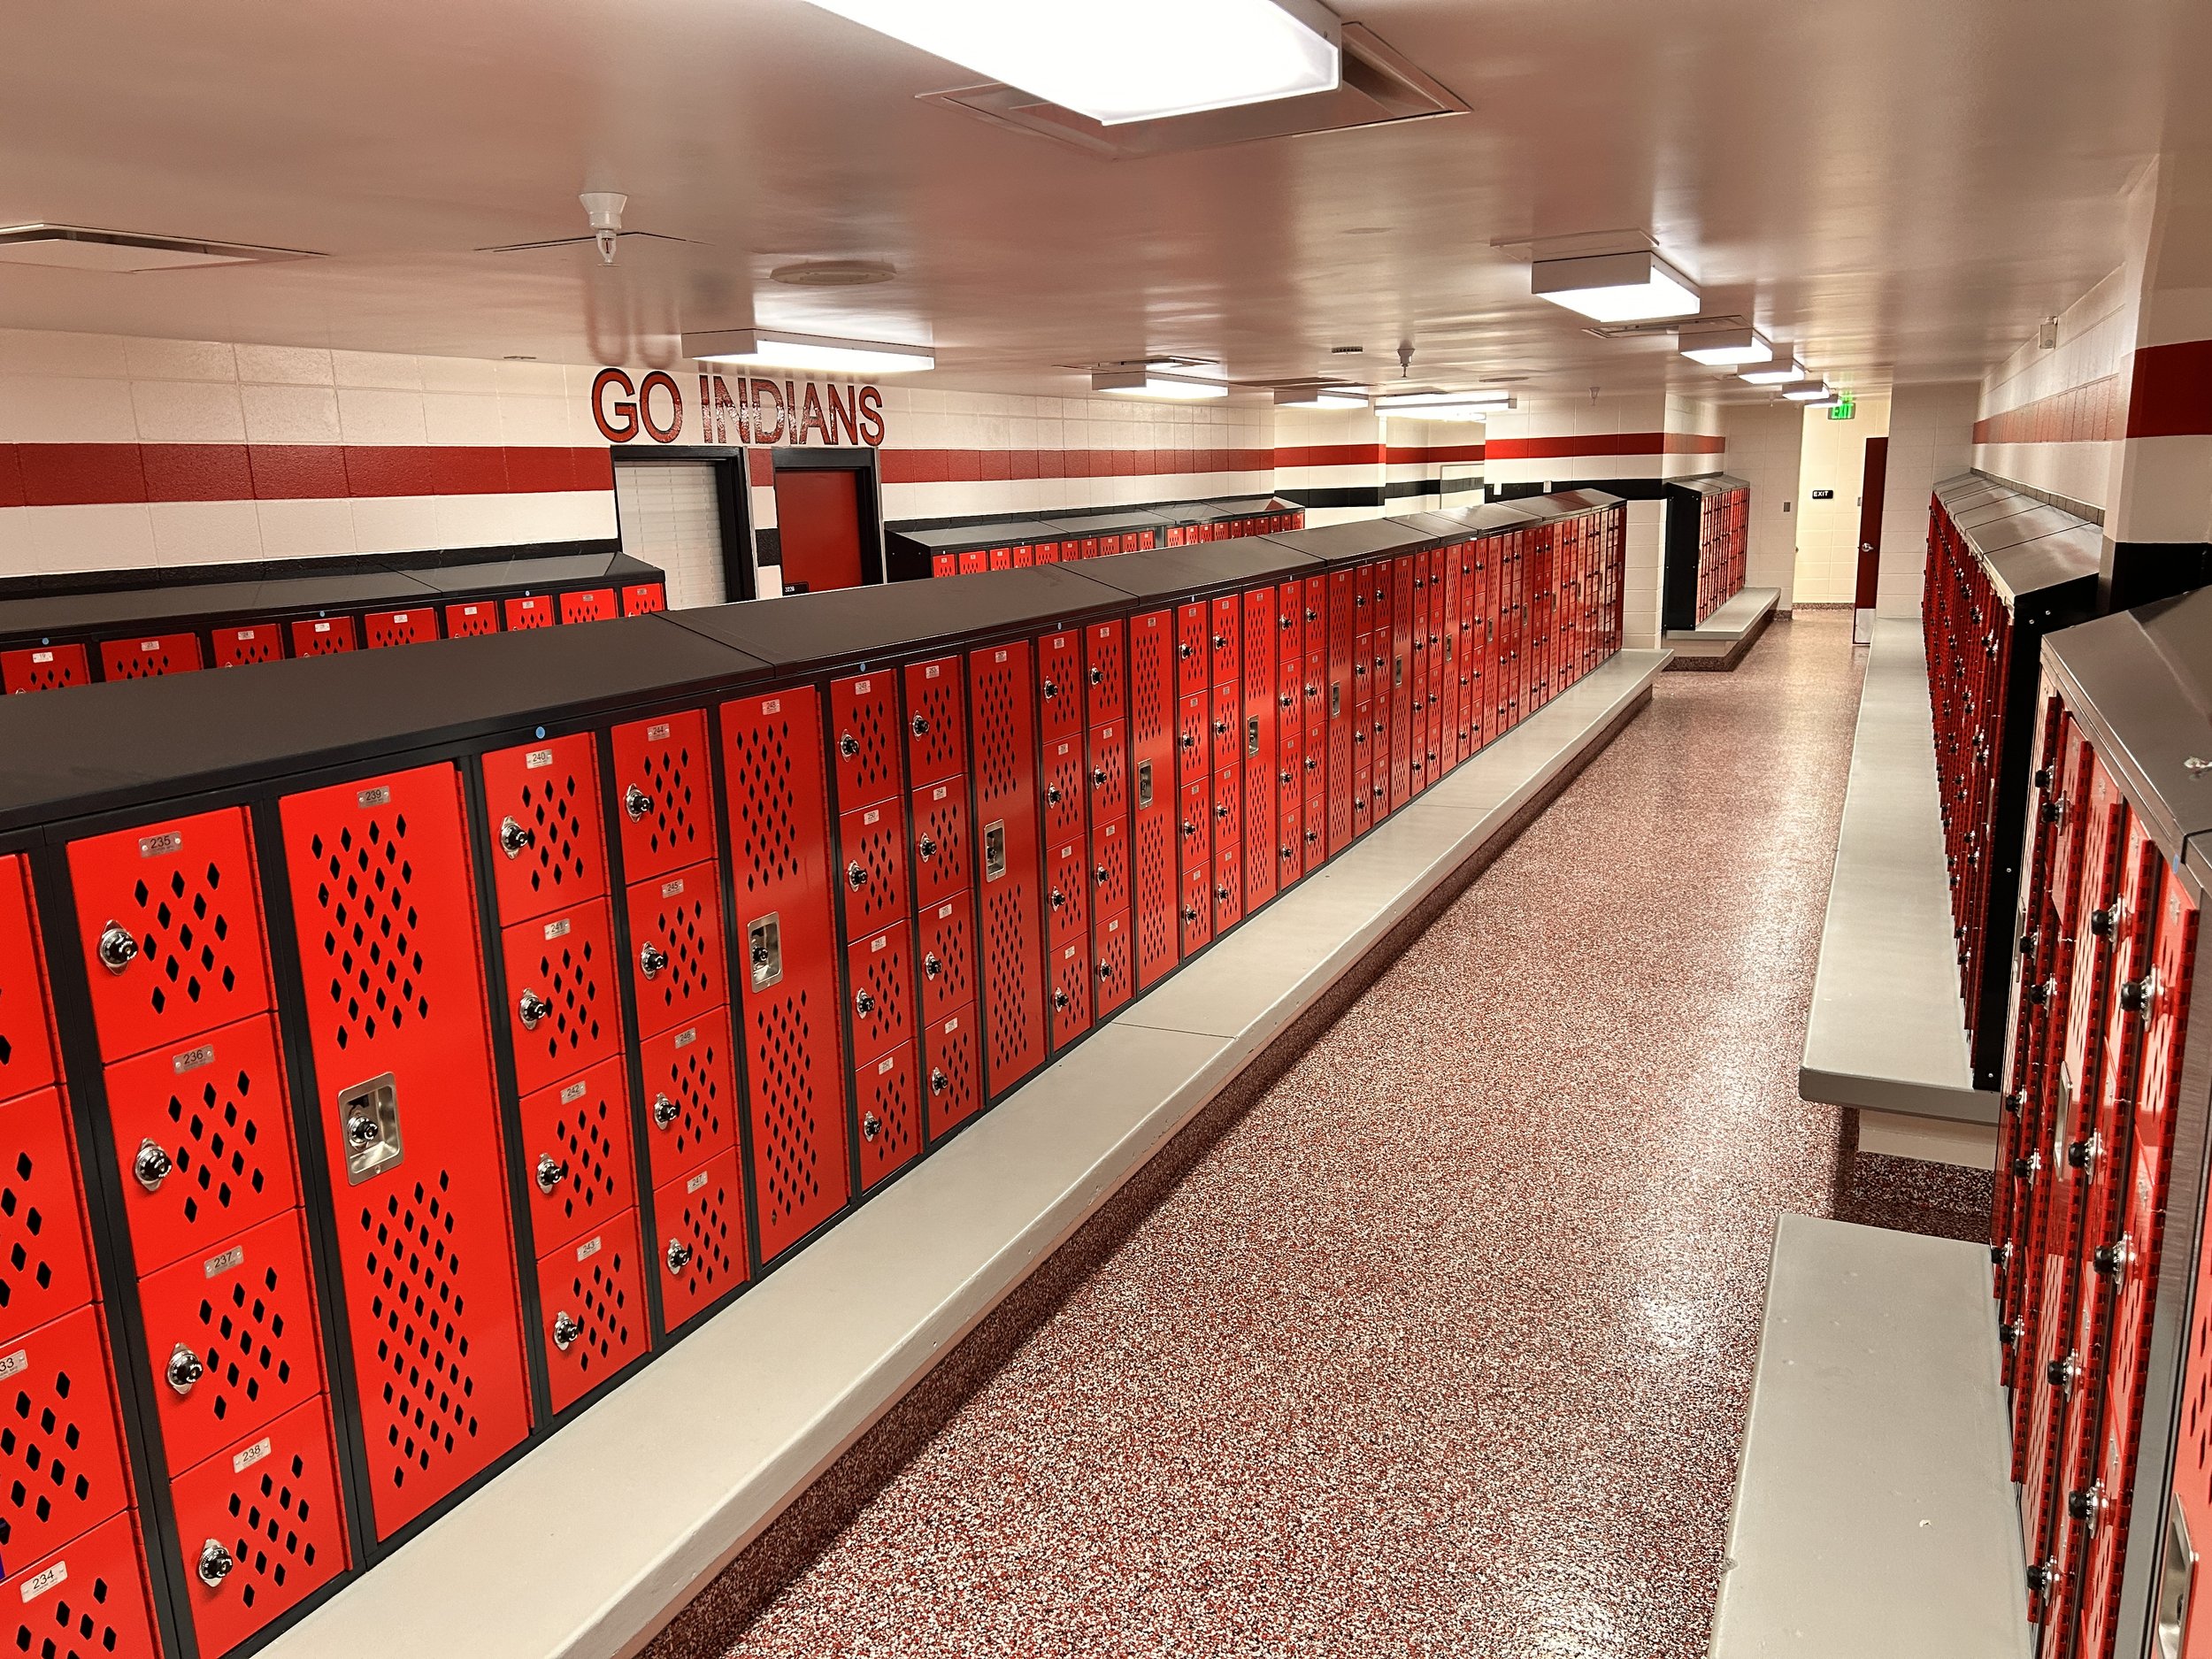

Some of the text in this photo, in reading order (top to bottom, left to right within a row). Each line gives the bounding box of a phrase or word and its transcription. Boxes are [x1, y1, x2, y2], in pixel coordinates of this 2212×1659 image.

[592, 367, 885, 446] GO INDIANS
[1832, 403, 1854, 419] EXIT
[653, 726, 664, 734] 244
[533, 752, 546, 762] 240
[365, 789, 381, 801] 239
[150, 835, 171, 849] 235
[667, 882, 678, 891] 245
[551, 922, 563, 933] 241
[680, 1032, 690, 1041] 246
[184, 1049, 204, 1064] 236
[567, 1085, 580, 1096] 242
[692, 1174, 703, 1187] 247
[583, 1240, 595, 1253] 243
[214, 1252, 232, 1268] 237
[0, 1357, 14, 1371] 33
[242, 1445, 261, 1462] 238
[33, 1570, 54, 1589] 234
